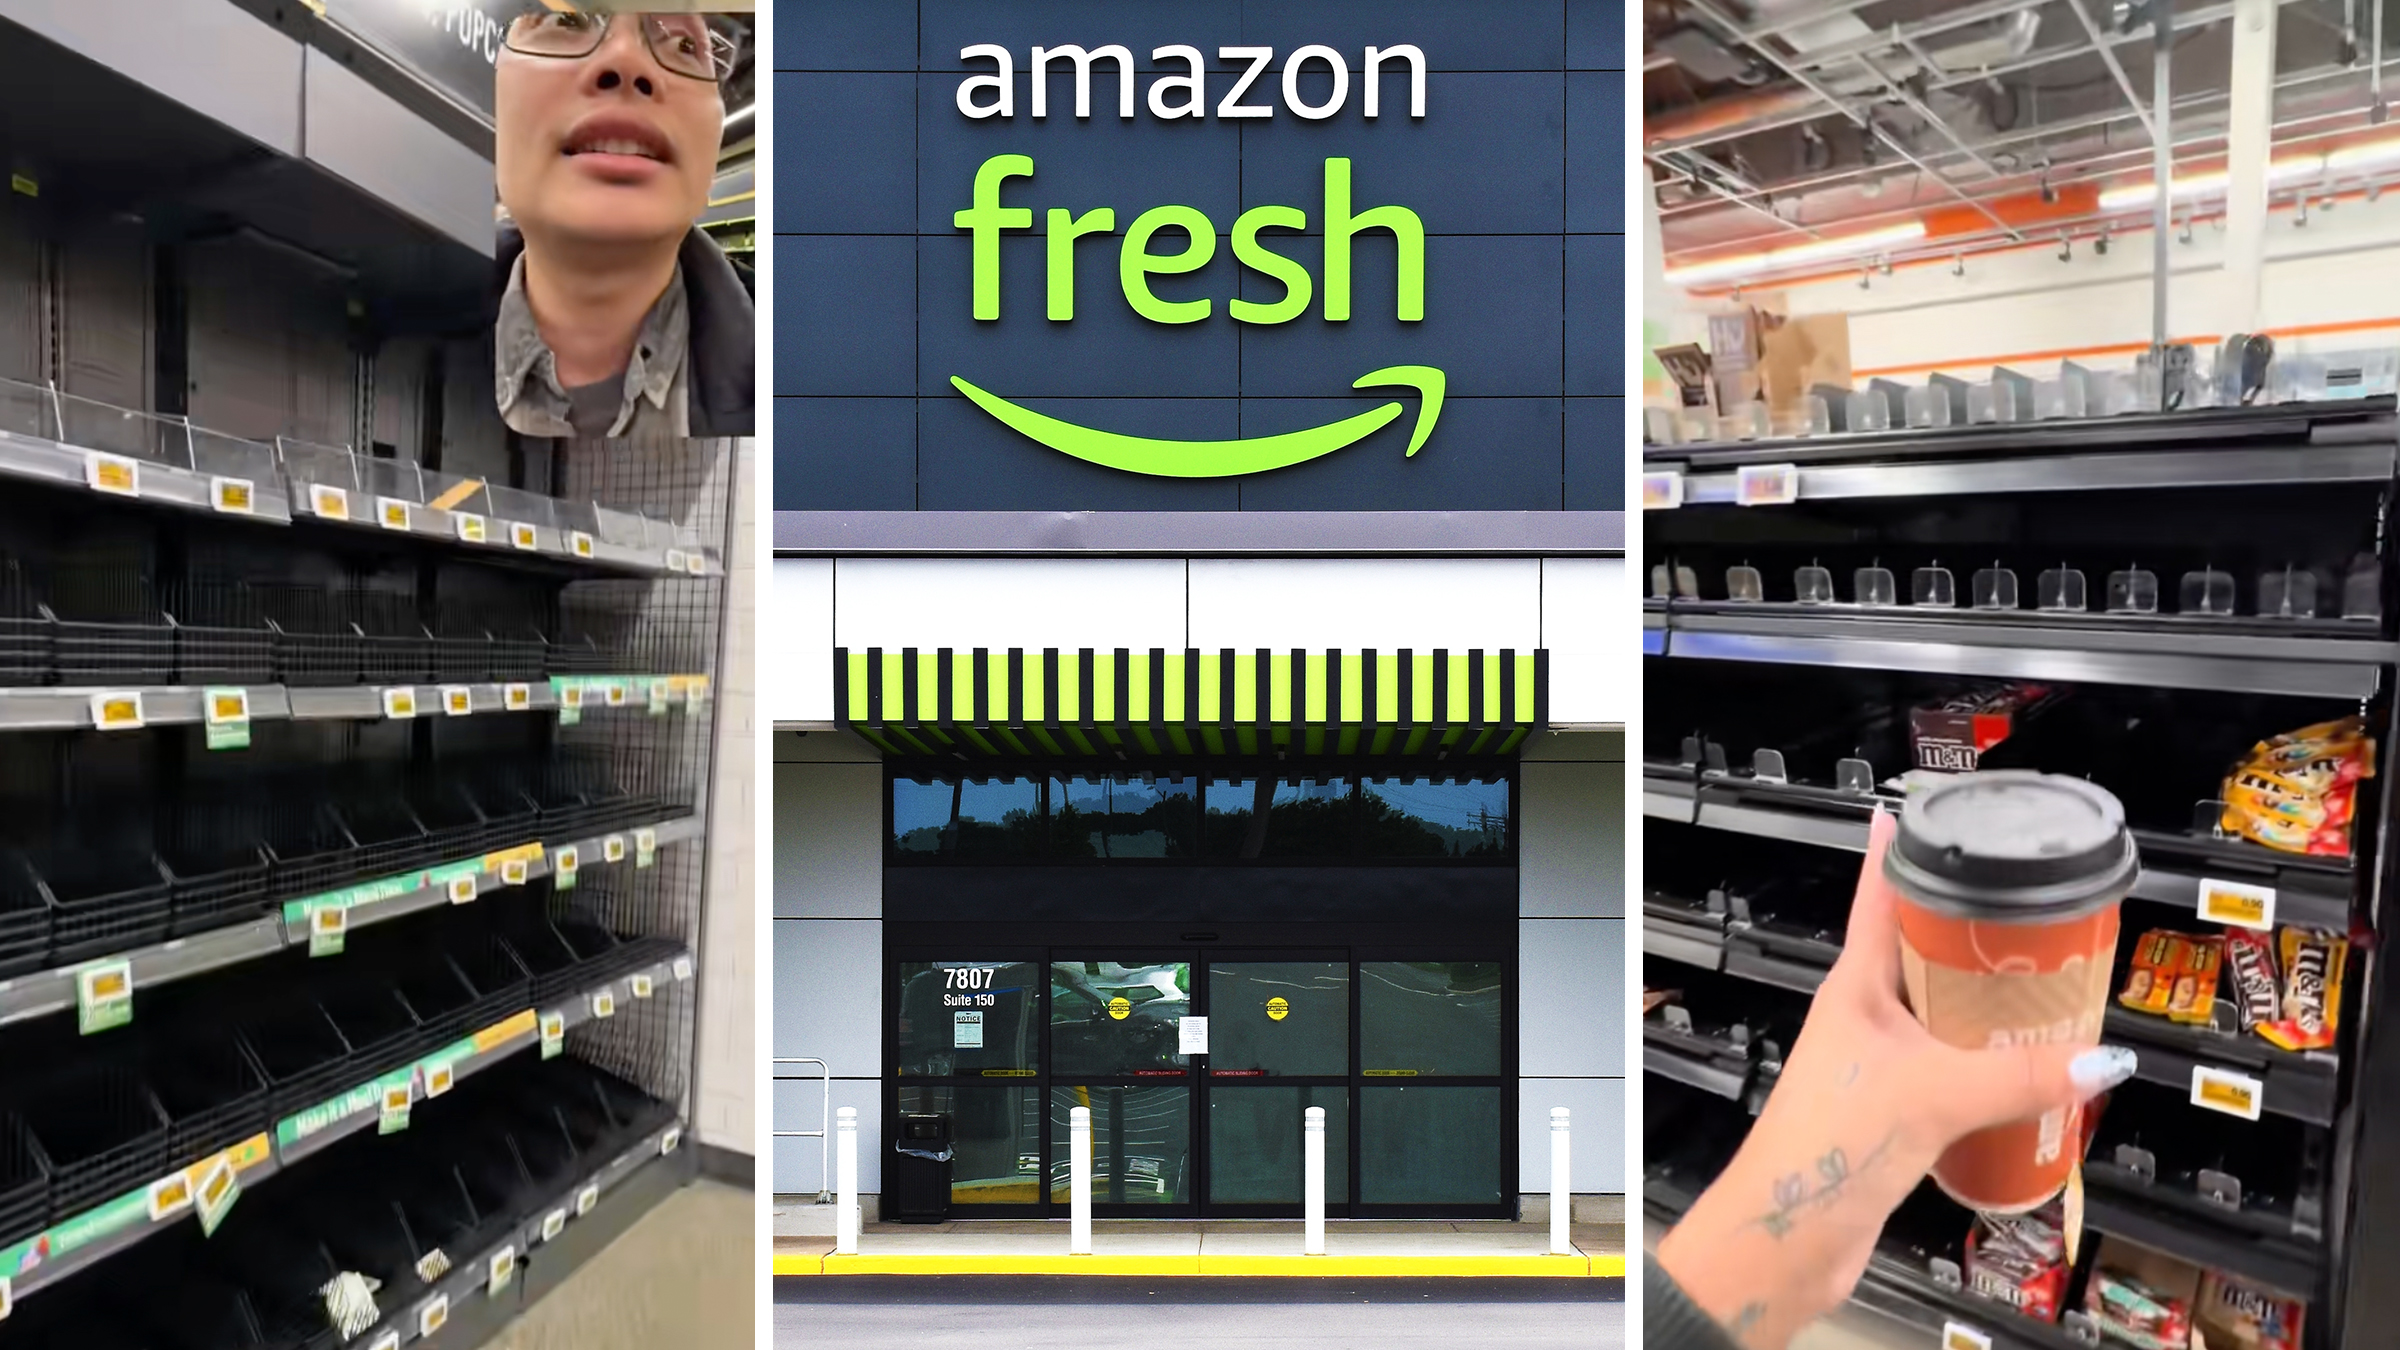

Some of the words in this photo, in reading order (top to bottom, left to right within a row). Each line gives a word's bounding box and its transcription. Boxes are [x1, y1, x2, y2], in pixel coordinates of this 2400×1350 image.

[956, 43, 1427, 120] amazon
[953, 153, 1426, 325] fresh
[944, 968, 995, 989] 7807
[944, 994, 972, 1006] Suite
[974, 994, 995, 1006] 150
